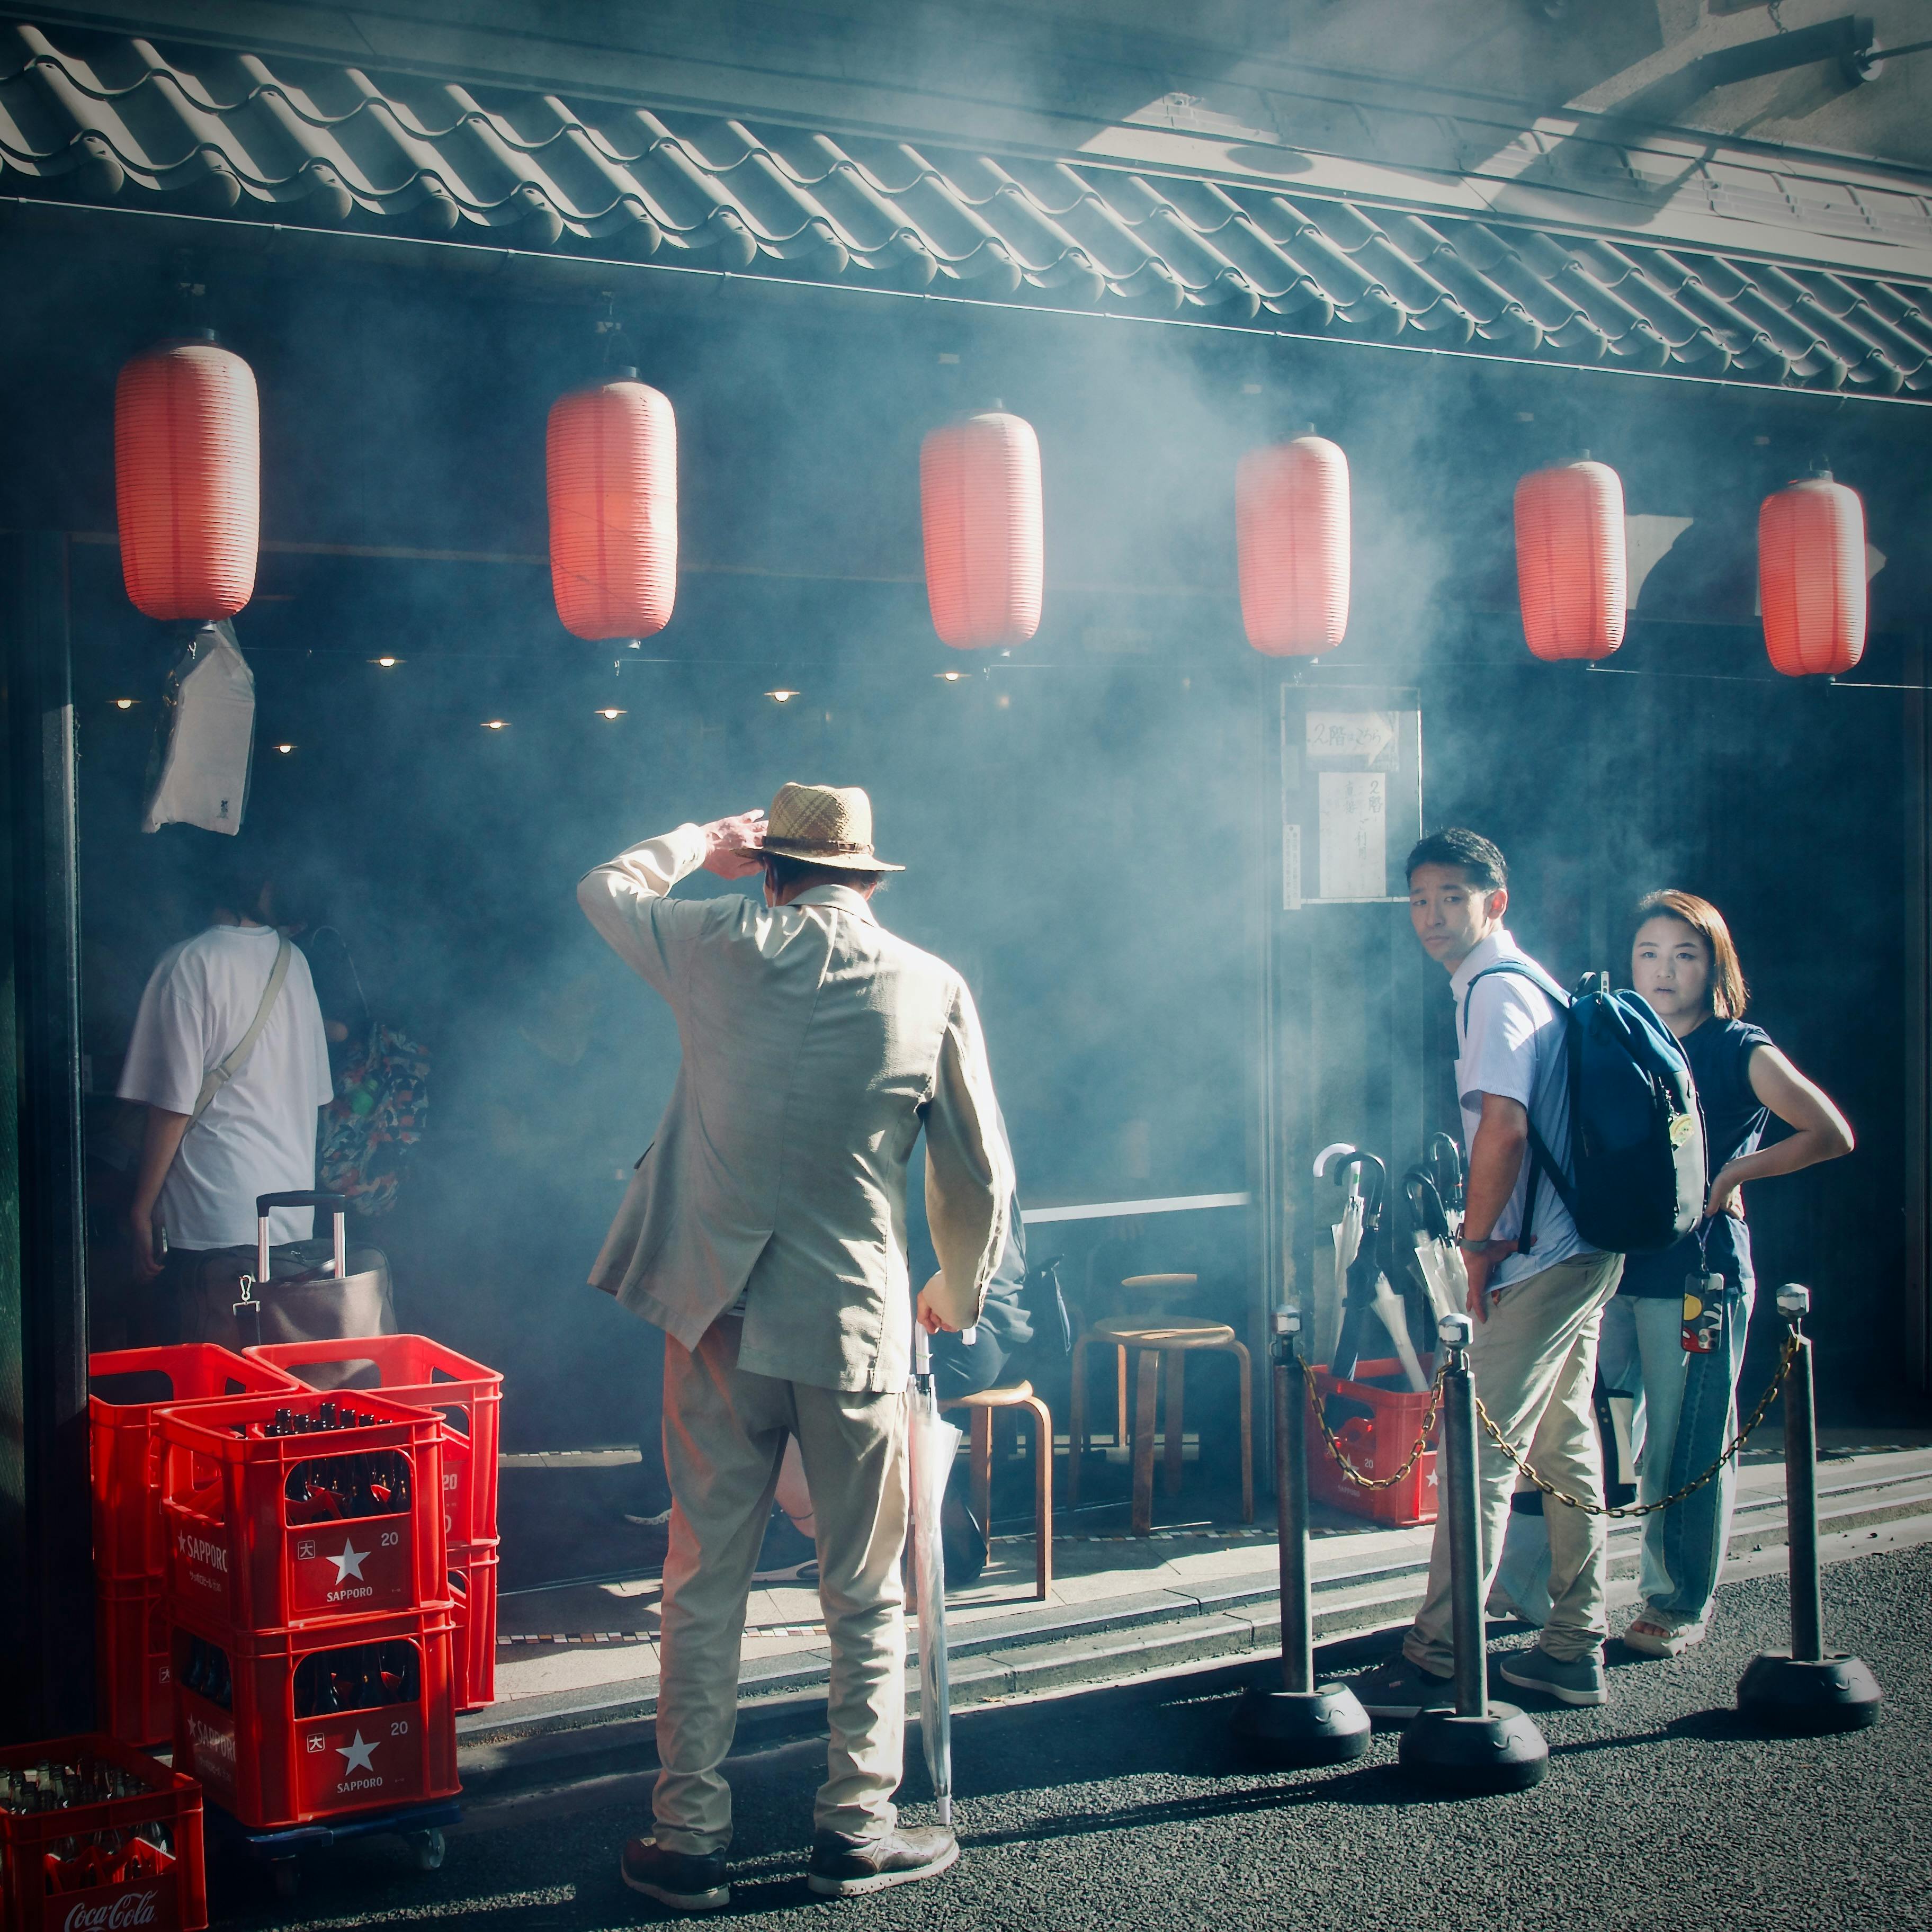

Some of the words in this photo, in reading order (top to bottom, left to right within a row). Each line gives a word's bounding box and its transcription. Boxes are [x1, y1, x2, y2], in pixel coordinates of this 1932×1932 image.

[1364, 1458, 1374, 1469] 20
[443, 1473, 458, 1491] 20
[1337, 1485, 1361, 1497] SAPPORO
[381, 1532, 399, 1546] 20
[300, 1543, 314, 1558] 大
[327, 1586, 373, 1602] SAPPORO
[391, 1721, 408, 1736] 20
[309, 1736, 323, 1750] 大
[337, 1776, 383, 1794] SAPPORO
[64, 1889, 158, 1932] Coca-Cola
